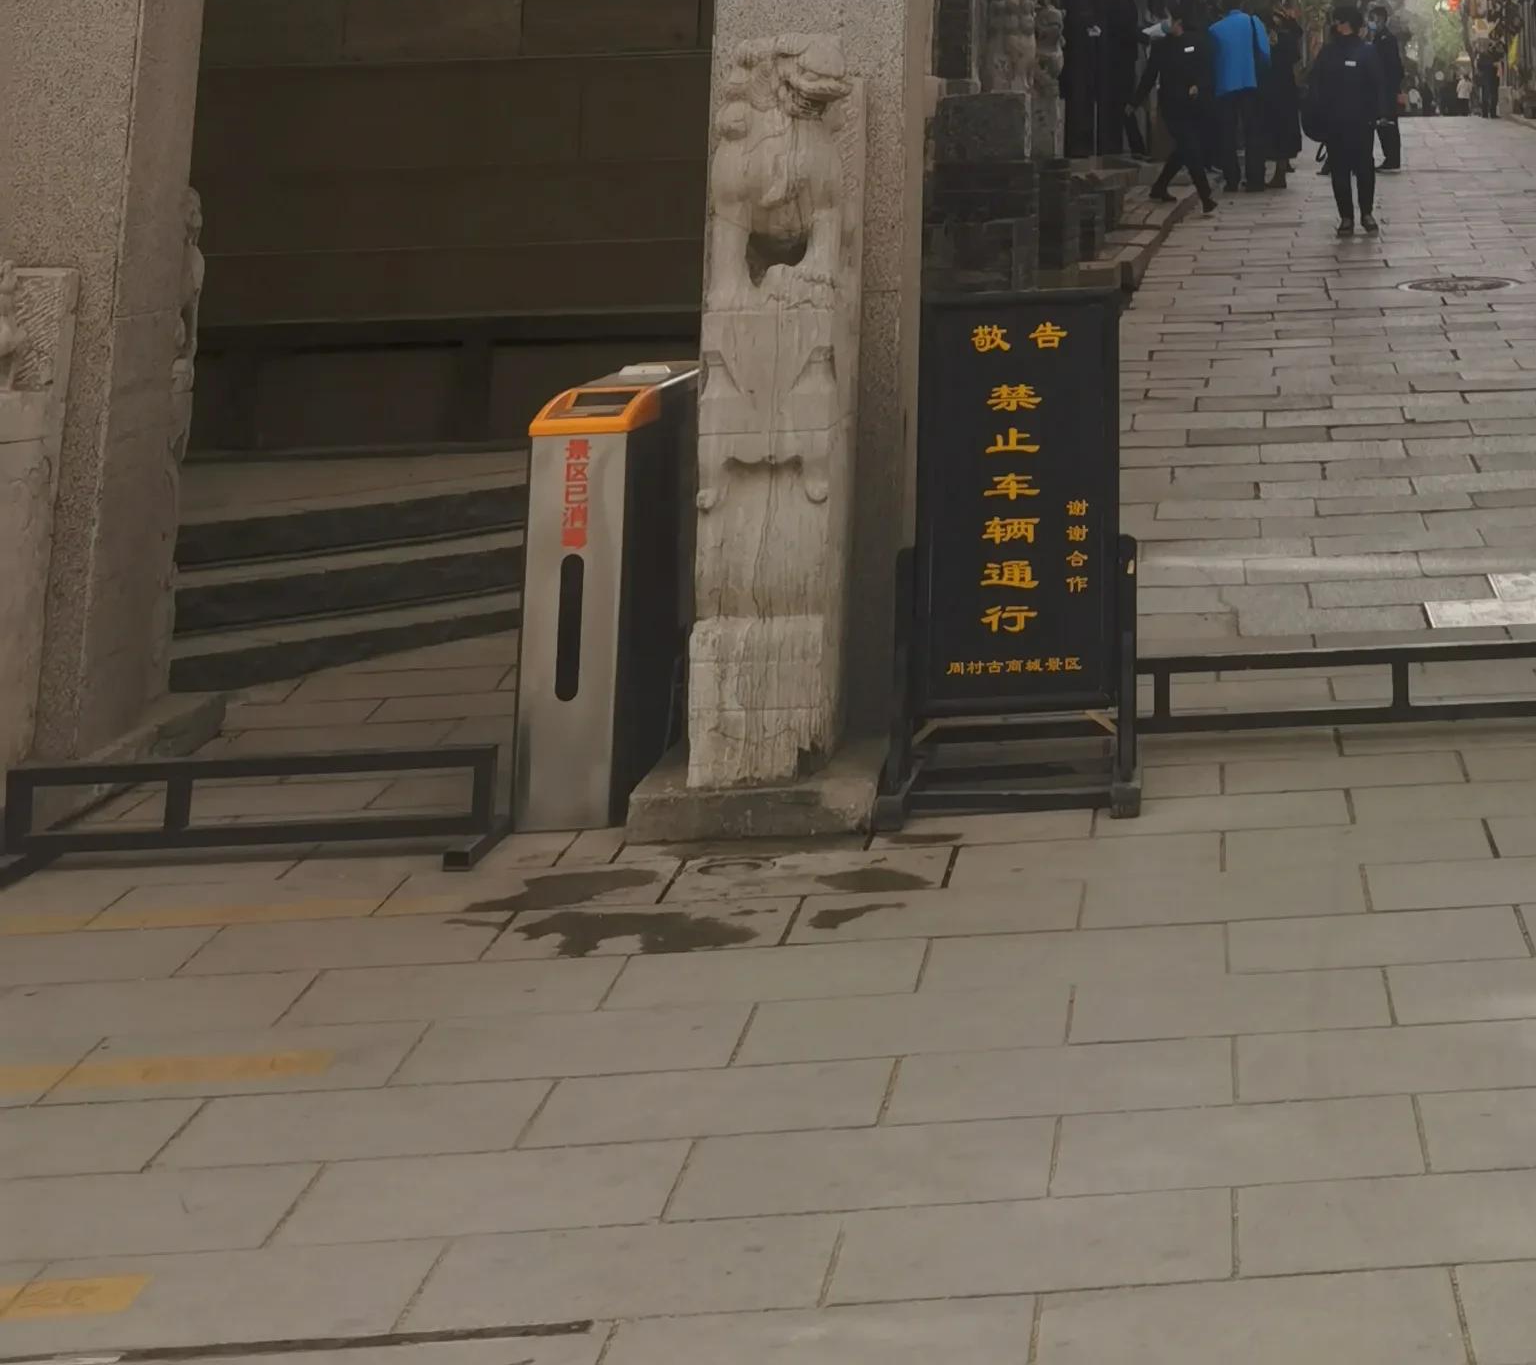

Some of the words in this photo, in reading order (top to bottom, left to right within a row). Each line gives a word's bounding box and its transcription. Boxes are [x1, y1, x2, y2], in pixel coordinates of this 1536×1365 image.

[971, 322, 1068, 352] 敬告
[980, 383, 1043, 634] 禁止车辆通行
[1065, 499, 1089, 593] 谢谢合作
[945, 657, 1083, 677] 周村古商城景区
